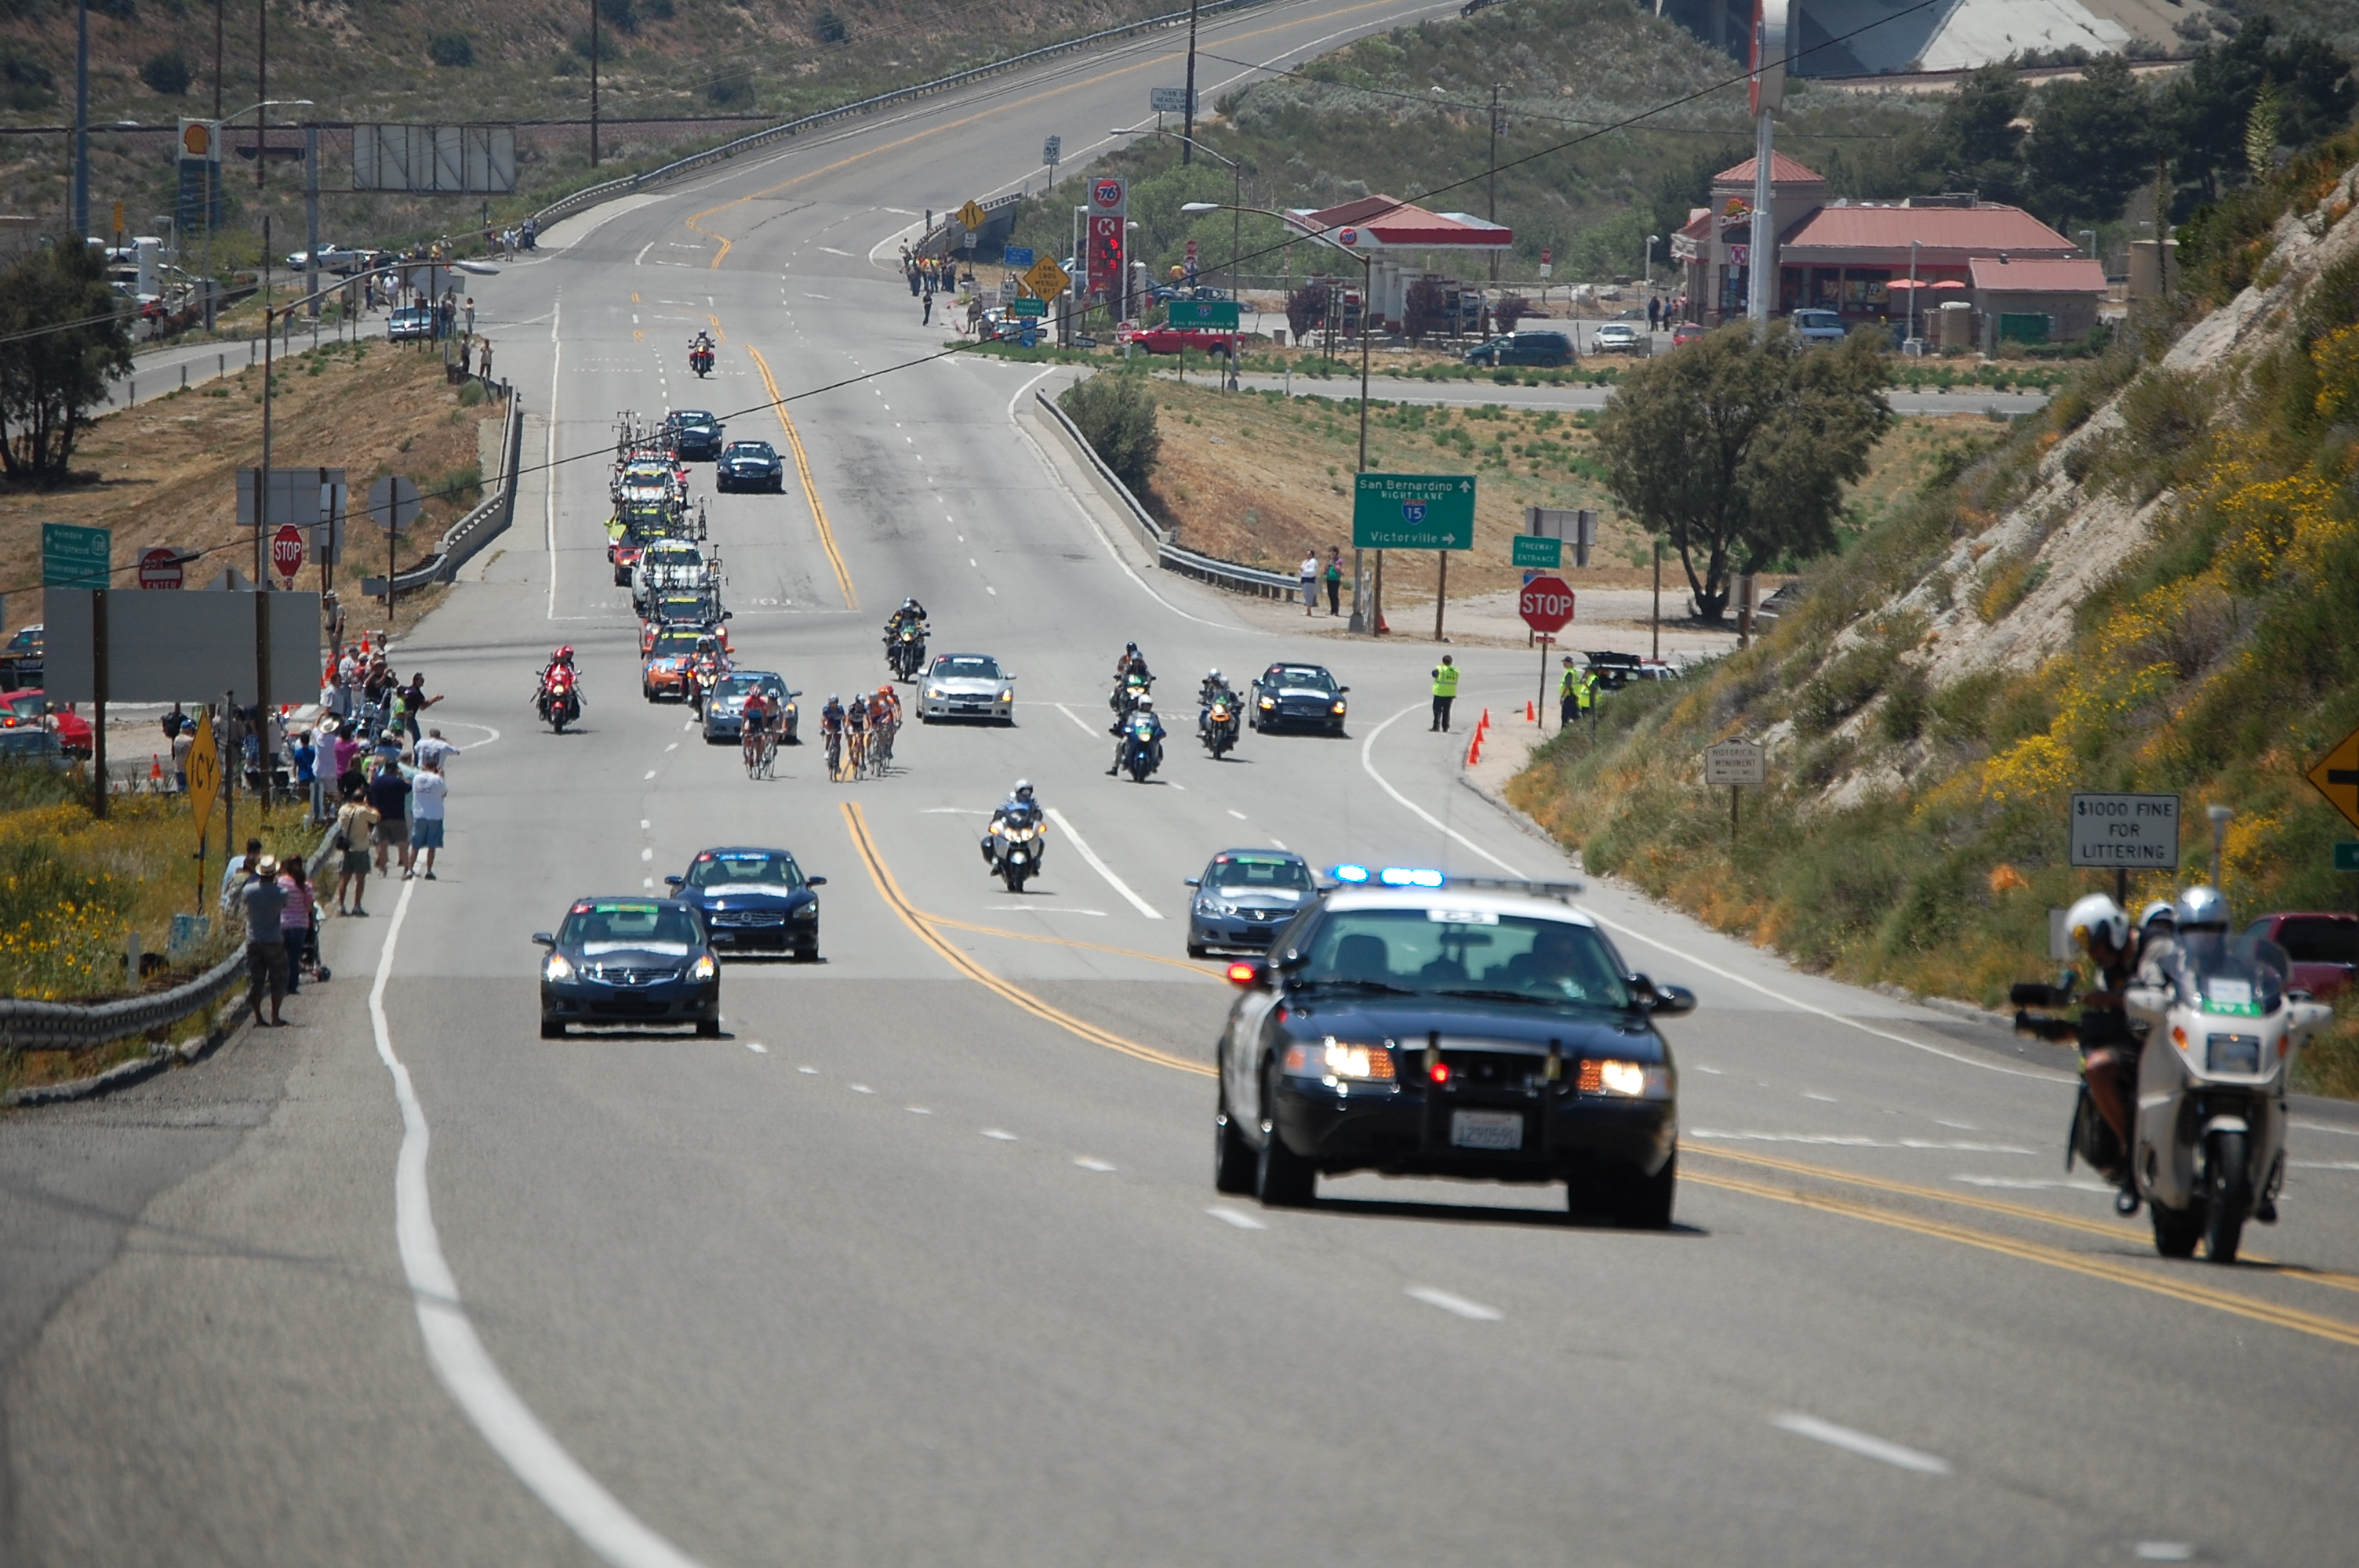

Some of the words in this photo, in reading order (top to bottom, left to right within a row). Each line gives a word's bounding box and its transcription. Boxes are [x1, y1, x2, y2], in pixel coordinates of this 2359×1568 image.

[1099, 186, 1117, 200] 76
[1342, 231, 1356, 242] 76
[1360, 480, 1383, 490] San
[1387, 480, 1452, 492] Bernardino
[1381, 491, 1412, 499] RIGHT
[1407, 507, 1423, 520] 15
[1371, 532, 1438, 543] Victorville
[275, 540, 301, 561] STOP
[1521, 542, 1554, 551] FREEWAY
[144, 559, 157, 568] DO
[1518, 554, 1556, 563] ENTRANCE
[147, 582, 176, 590] ENTER
[1522, 593, 1572, 616] STOP
[1715, 759, 1756, 768] MONUMENT
[191, 751, 216, 791] ICY
[2078, 800, 2128, 816] $1000
[2137, 803, 2173, 817] FINE
[2110, 824, 2141, 837] FOR
[2083, 844, 2165, 859] LITTERING
